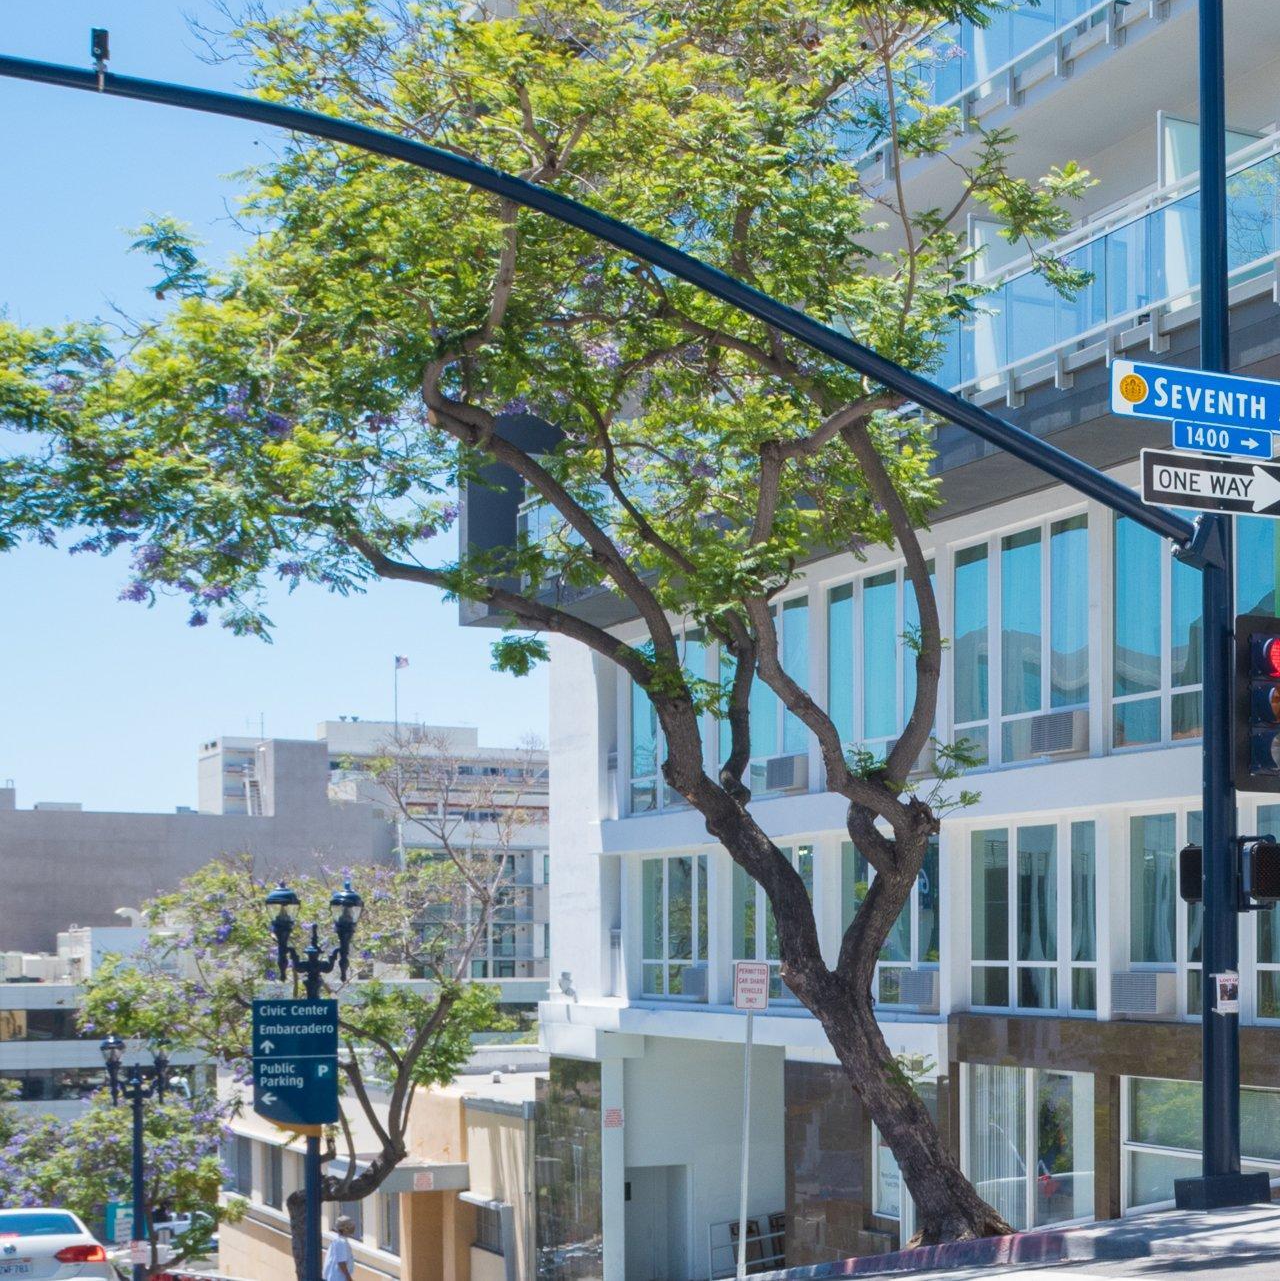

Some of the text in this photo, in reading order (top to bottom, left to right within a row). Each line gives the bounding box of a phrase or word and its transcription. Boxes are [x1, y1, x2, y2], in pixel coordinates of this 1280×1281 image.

[1154, 377, 1266, 421] SEVENTH
[1186, 426, 1230, 449] 1400
[1159, 468, 1254, 498] ONE WAY
[260, 1005, 328, 1016] Civic Center
[260, 1024, 334, 1035] Embarcadero
[260, 1063, 296, 1074] Public
[260, 1076, 304, 1089] Parking
